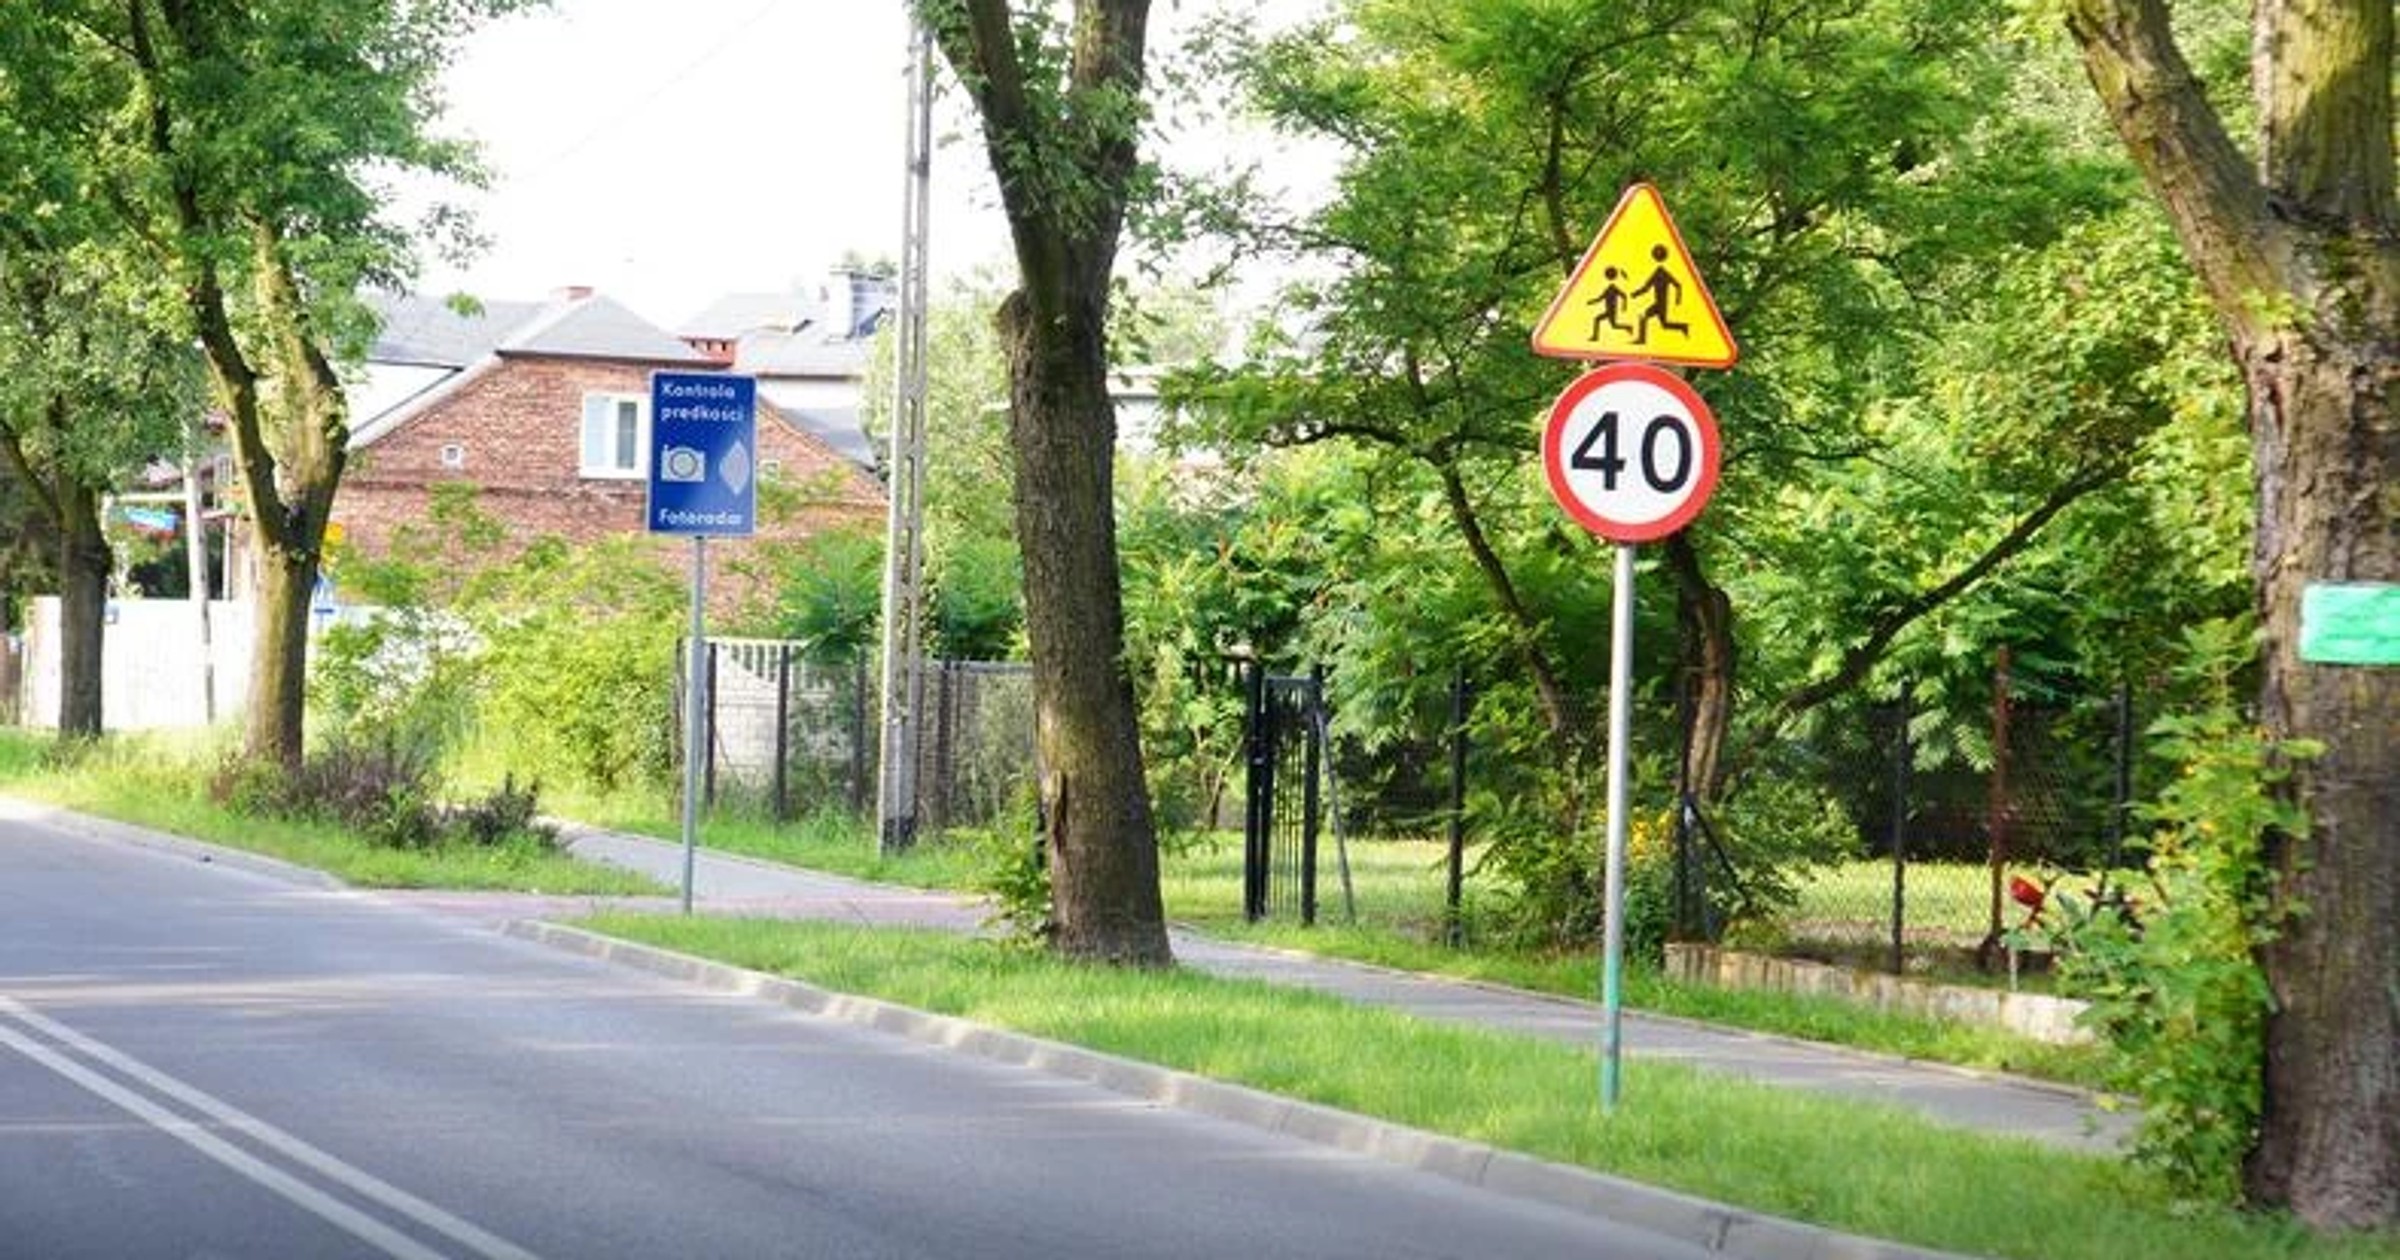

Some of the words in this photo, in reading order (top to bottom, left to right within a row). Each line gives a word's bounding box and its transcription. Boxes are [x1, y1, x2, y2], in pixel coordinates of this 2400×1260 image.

[661, 382, 735, 399] Kontrola
[1571, 411, 1692, 493] 40
[659, 508, 742, 525] Fotoradar
